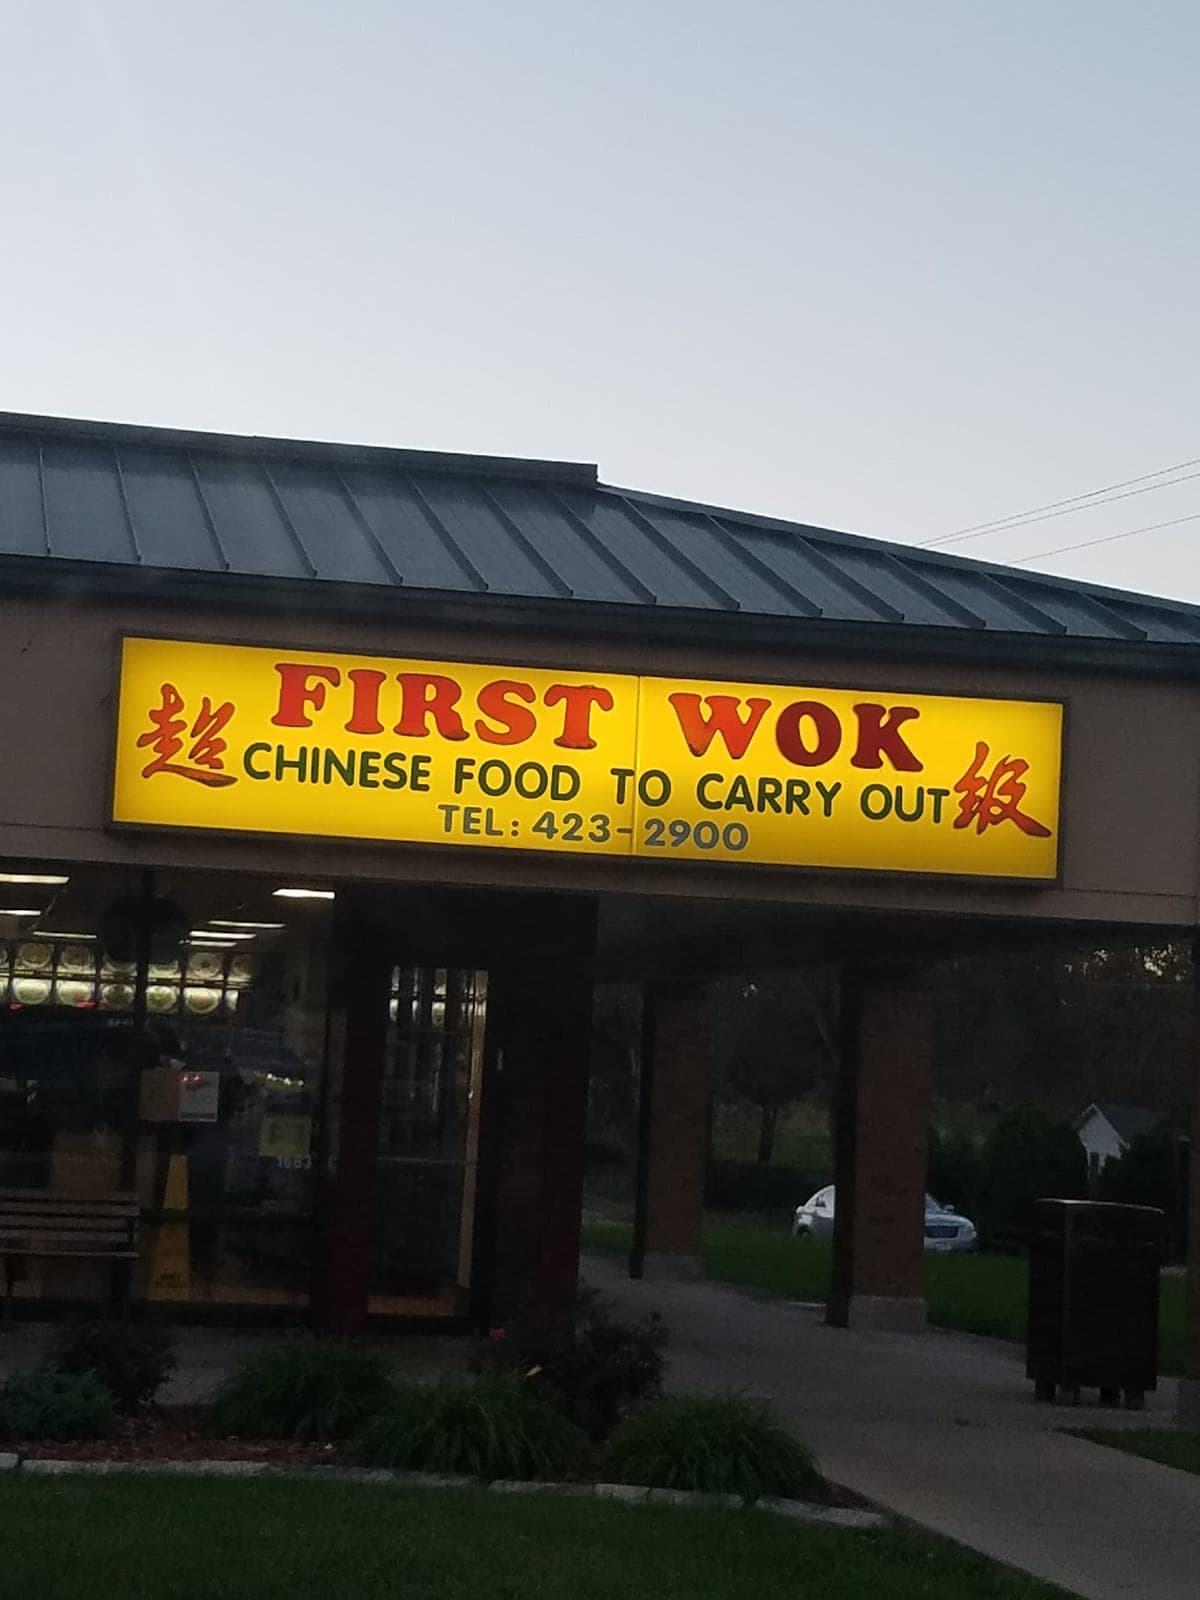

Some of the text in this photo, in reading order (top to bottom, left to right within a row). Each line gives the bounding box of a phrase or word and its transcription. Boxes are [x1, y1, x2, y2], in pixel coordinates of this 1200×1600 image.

[136, 682, 239, 789] 超
[270, 662, 924, 773] FIRST WOK
[242, 741, 951, 825] CHINESE FOOD TO CARRY OUT
[437, 803, 520, 838] TEL:
